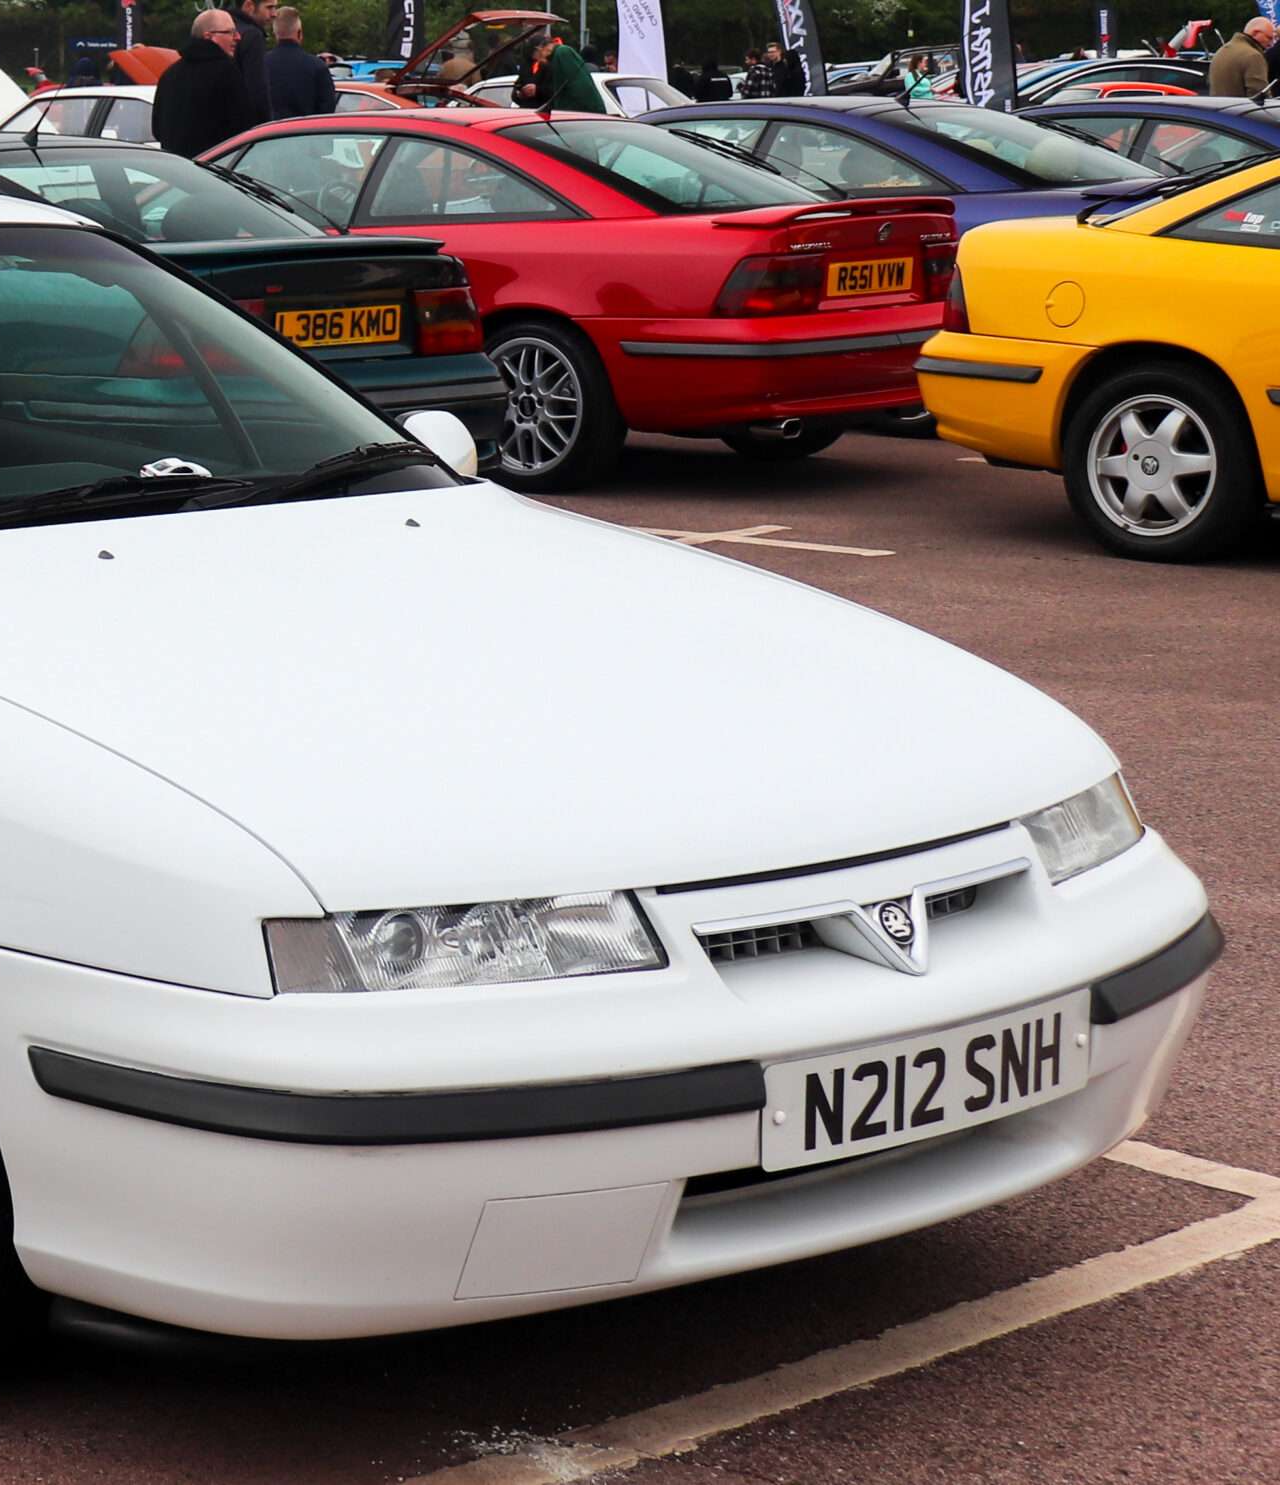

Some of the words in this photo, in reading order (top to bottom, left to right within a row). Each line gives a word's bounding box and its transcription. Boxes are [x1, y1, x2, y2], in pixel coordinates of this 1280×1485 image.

[837, 263, 873, 292] R551
[876, 261, 906, 288] VVW
[349, 307, 397, 338] KMO
[804, 1046, 946, 1151] N212
[963, 1012, 1062, 1113] SNH
